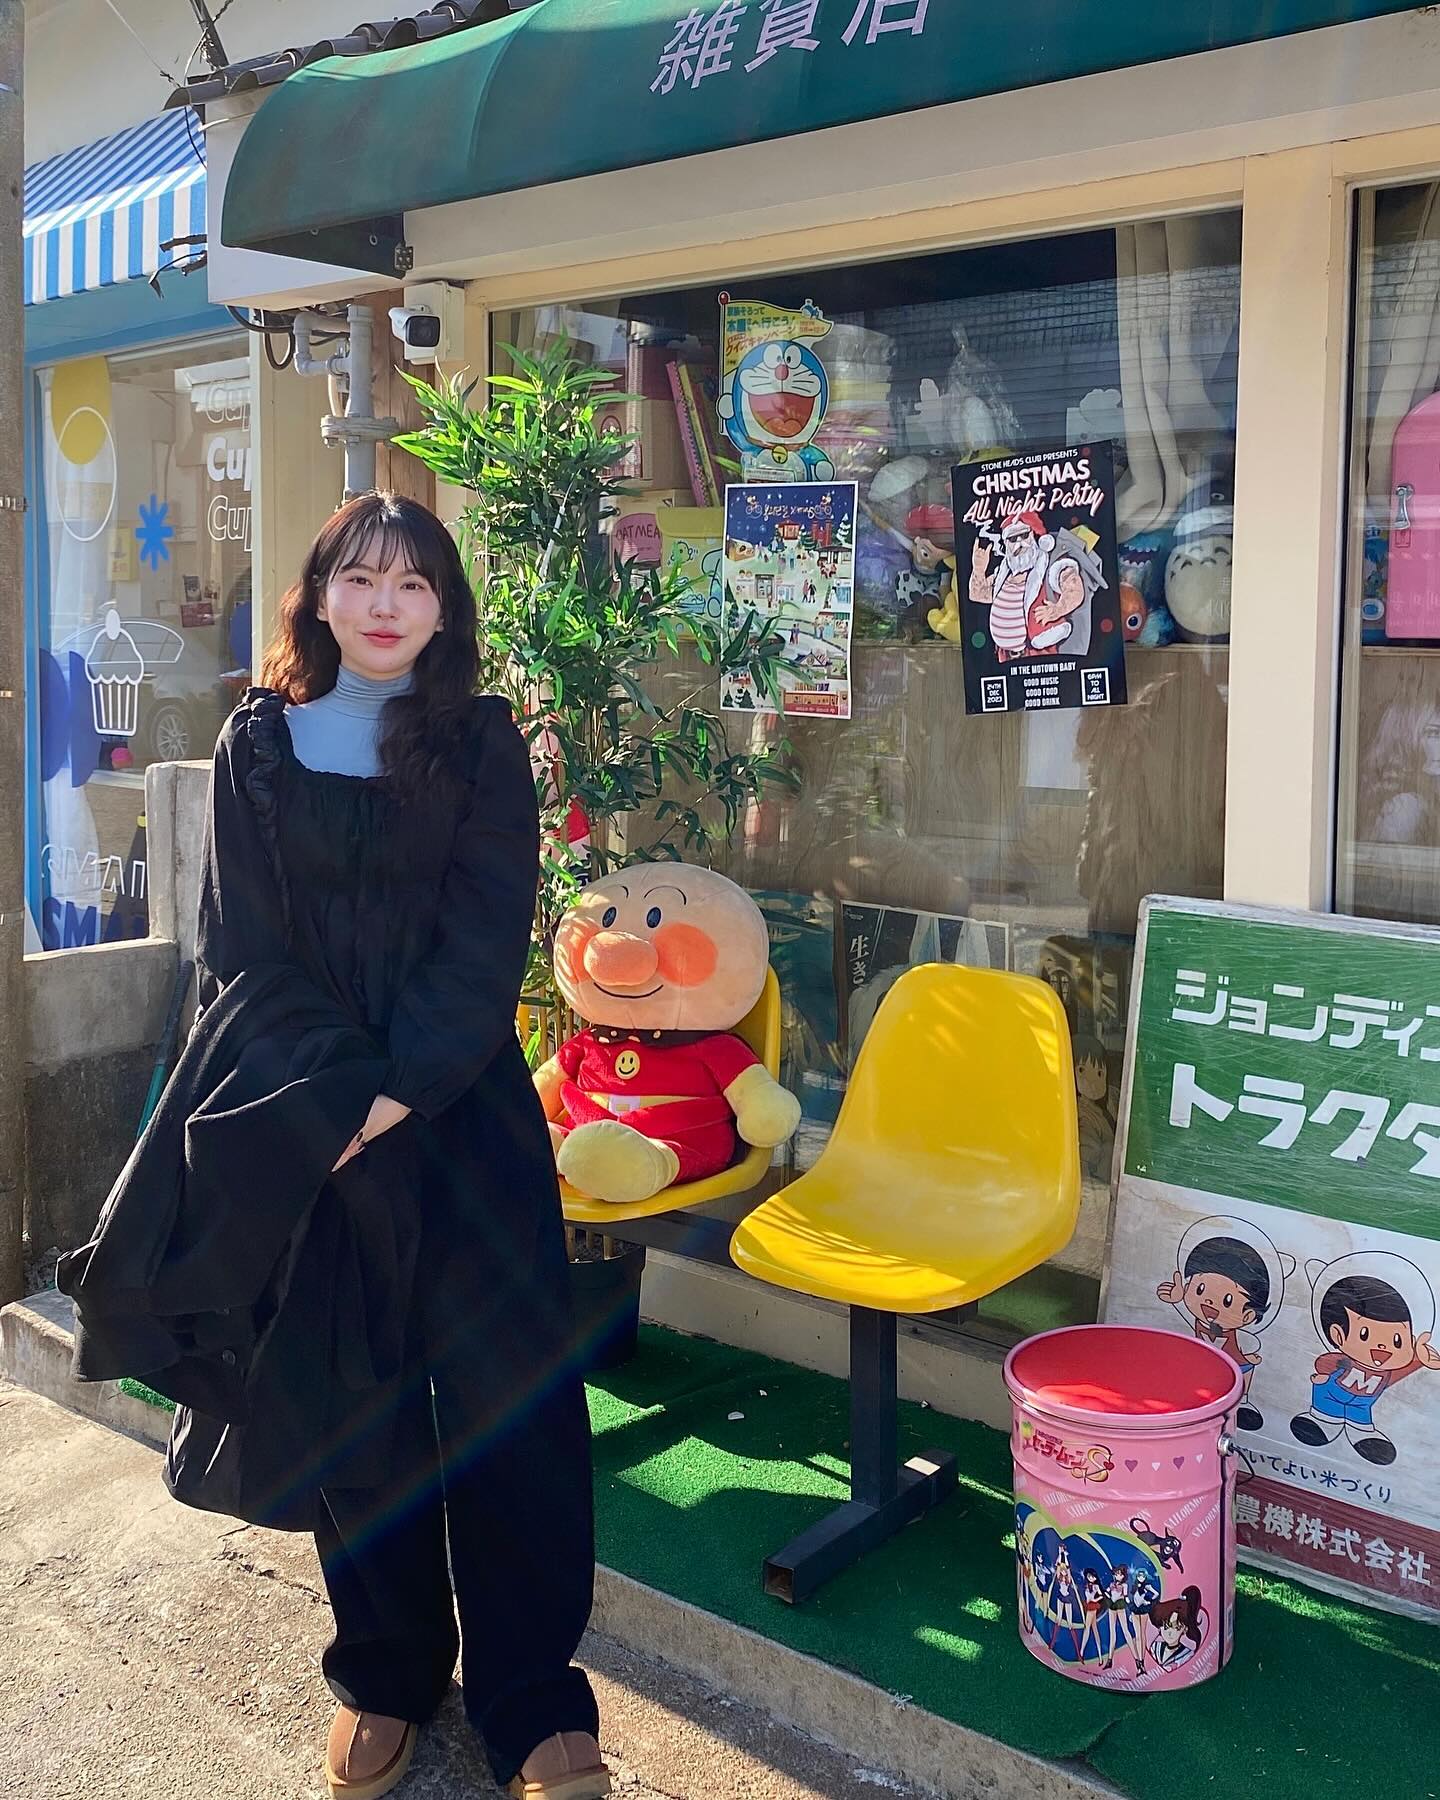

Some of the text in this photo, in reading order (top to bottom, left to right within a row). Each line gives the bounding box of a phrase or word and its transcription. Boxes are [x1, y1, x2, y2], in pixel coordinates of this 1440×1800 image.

[981, 449, 1078, 472] STONE HEADS CLUB PRESENTS
[972, 459, 1091, 496] CHRISTMAS
[963, 481, 1104, 523] All Night Party
[616, 524, 662, 541] OATMEA
[1010, 662, 1077, 676] IN THE MOTOWN BABY
[1023, 677, 1059, 687] GOOD MUSIC
[1025, 687, 1058, 697] GOOD FOOD
[1024, 697, 1061, 708] GOOD DRINK
[1169, 1062, 1440, 1178] トラクタ
[1236, 1493, 1431, 1586] 農機株式会社
